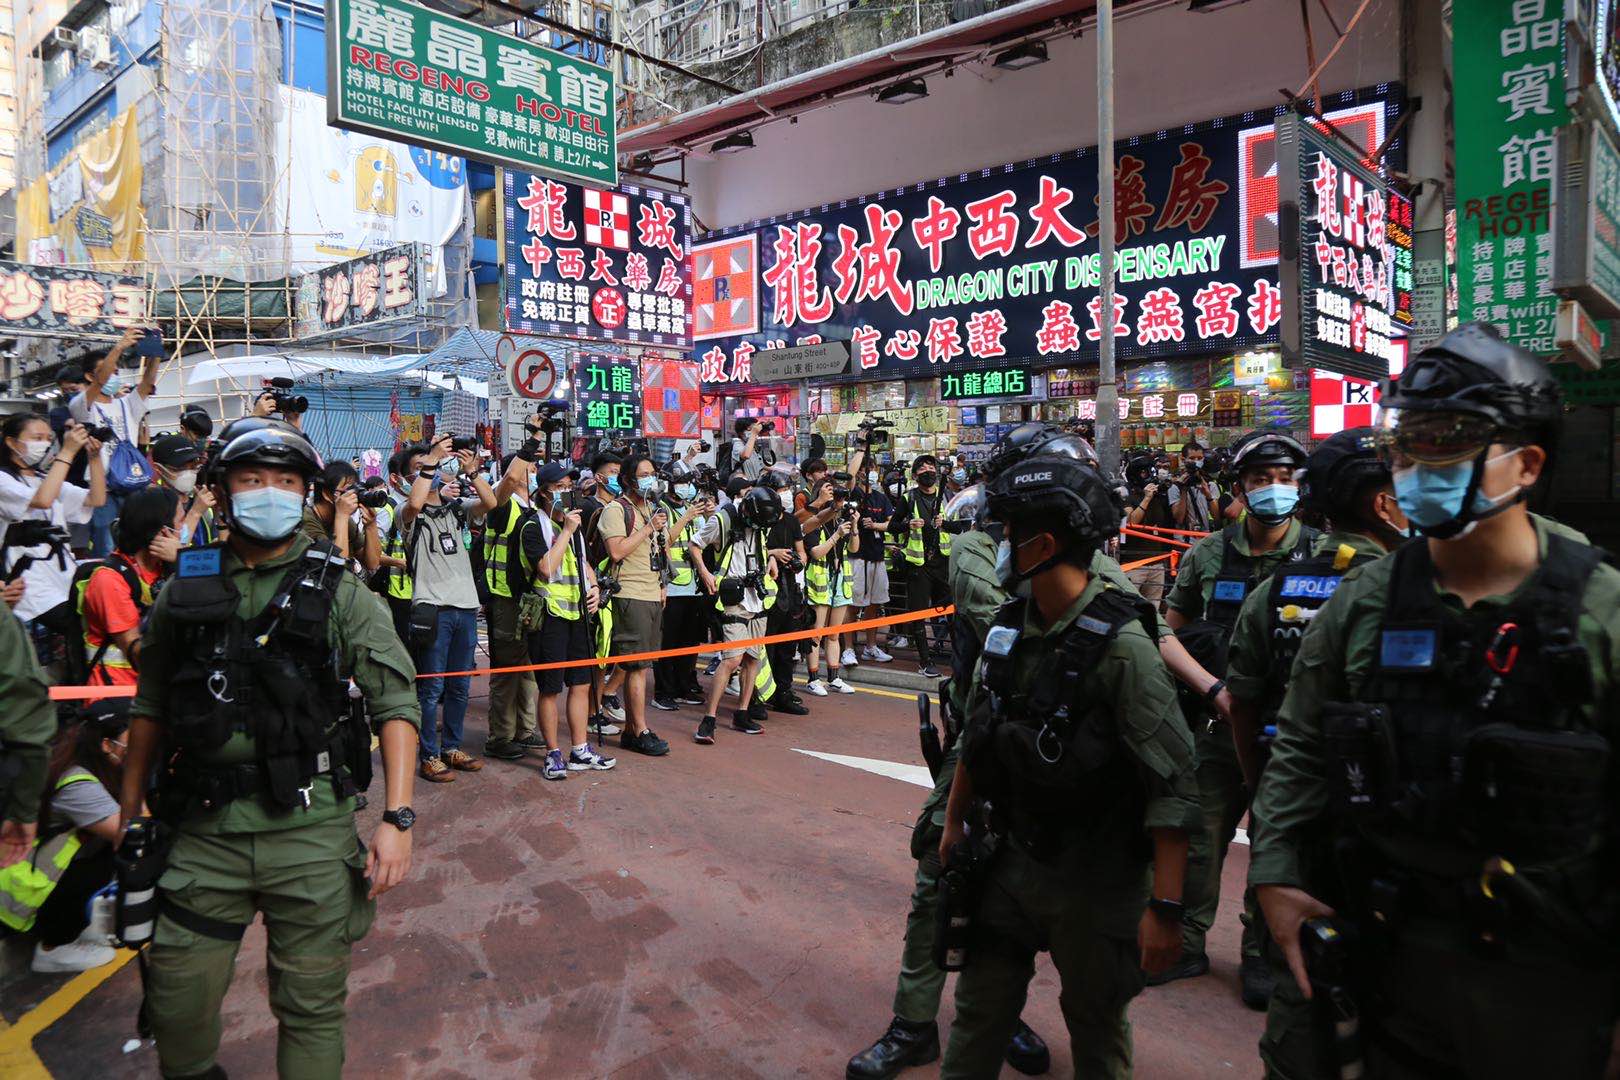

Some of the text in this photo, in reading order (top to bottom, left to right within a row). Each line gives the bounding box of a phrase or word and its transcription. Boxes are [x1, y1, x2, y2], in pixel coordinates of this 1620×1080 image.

[346, 0, 609, 117] 麗晶賓館
[350, 44, 607, 138] REGENG HOTEL
[346, 66, 610, 155] 持牌賓館 酒店設備 豪華套房 歡迎自由行
[346, 89, 479, 132] HOTEL FACILITY LIENSED
[347, 101, 440, 133] HOTEL FREE WIFI
[517, 175, 684, 261] 龍 城
[1479, 211, 1551, 240] HOT
[521, 237, 684, 298] 中西大藥房
[521, 278, 590, 306] 政府註冊
[916, 267, 1003, 310] DRAGON
[1007, 259, 1058, 297] CITY
[600, 303, 619, 325] 正
[771, 348, 827, 362] Shantung Street
[851, 309, 1007, 370] 信心保證
[586, 364, 632, 394] 九龍
[784, 362, 813, 375] 山東街
[943, 370, 1025, 398] 九龍總店
[588, 401, 634, 429] 總店
[1014, 470, 1053, 486] POLICE
